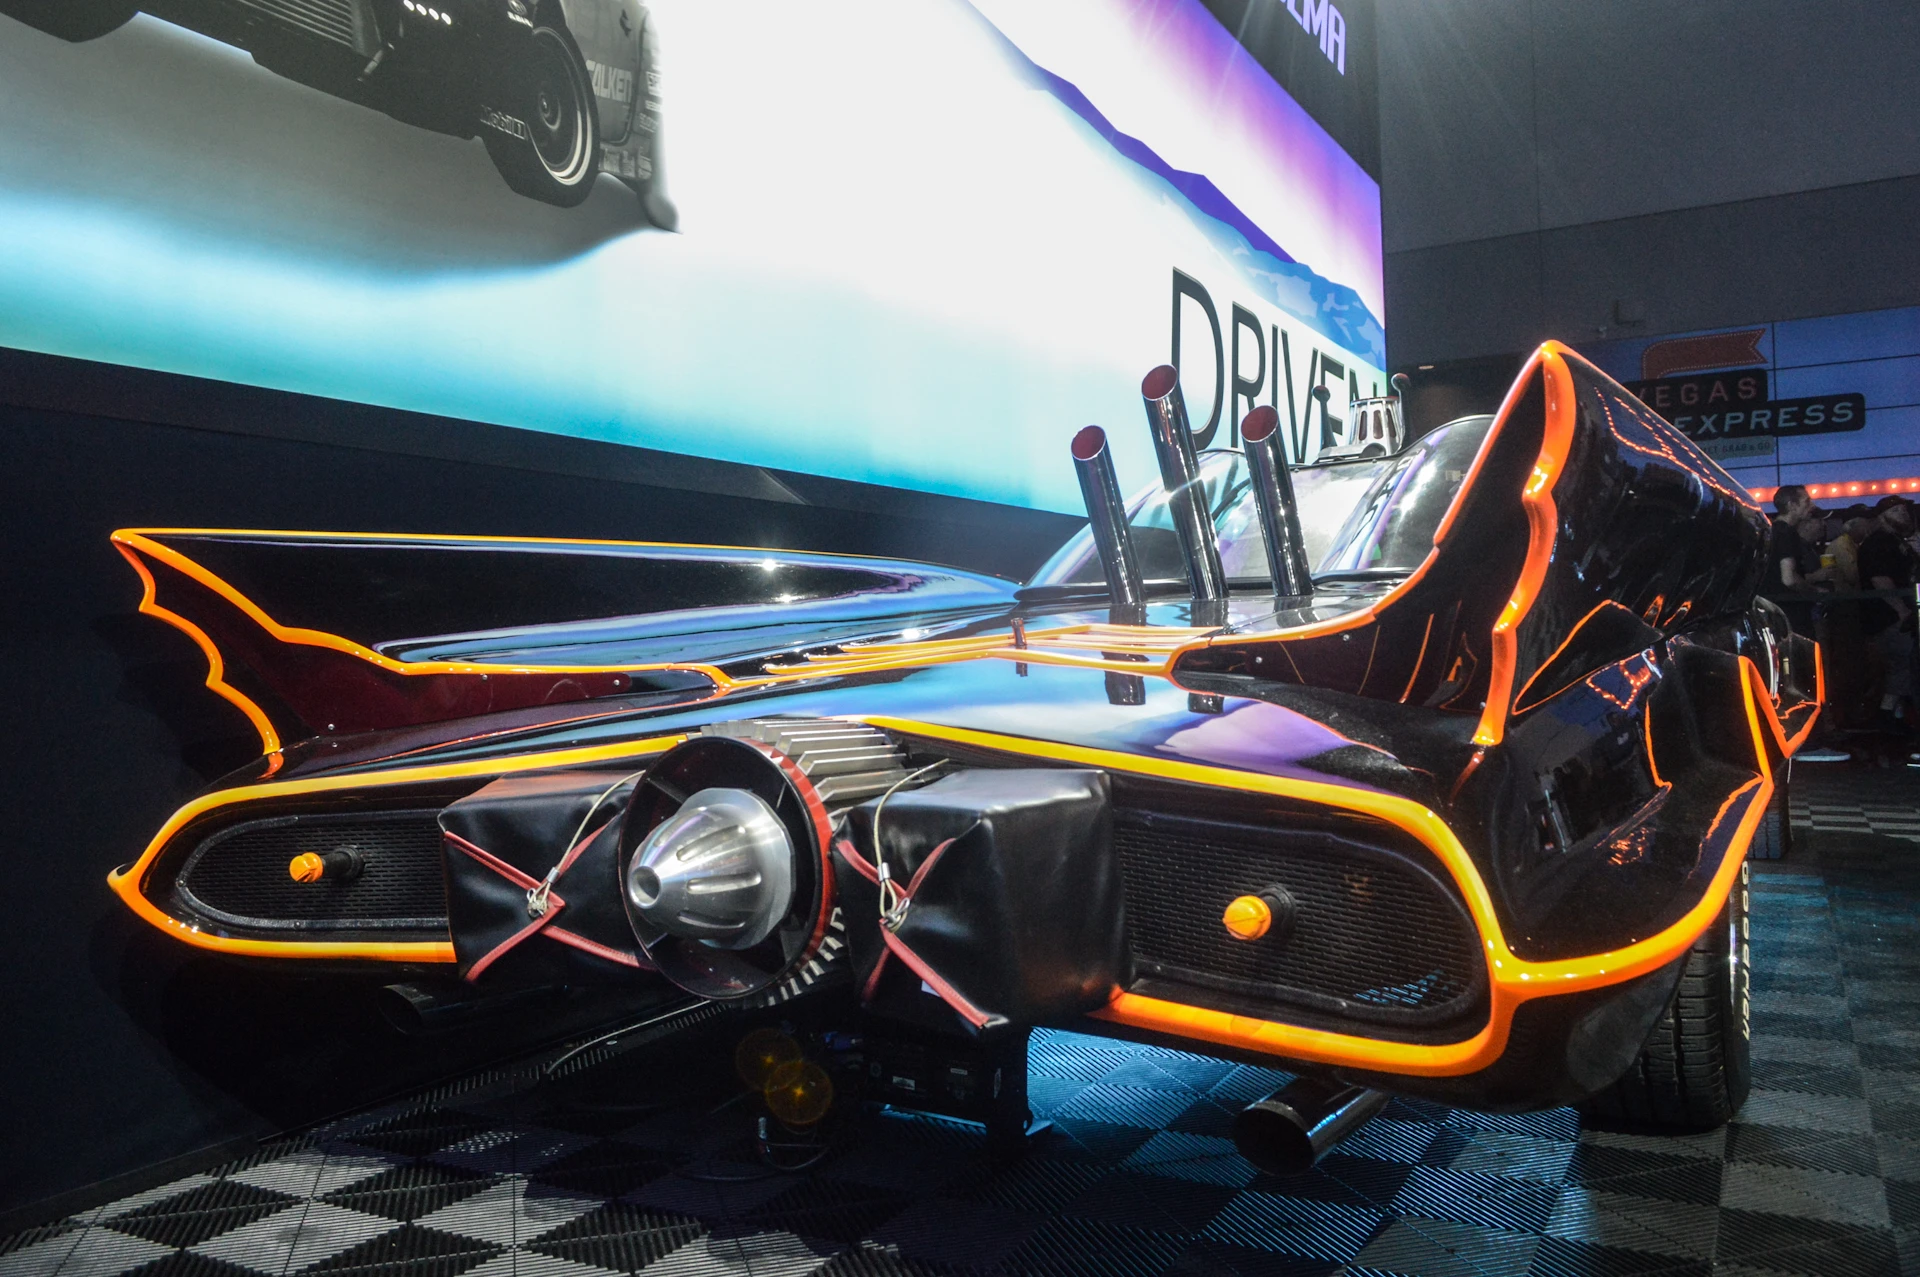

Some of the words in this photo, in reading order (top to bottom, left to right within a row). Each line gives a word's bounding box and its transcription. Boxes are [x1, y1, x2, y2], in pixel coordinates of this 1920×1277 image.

[1280, 0, 1346, 76] MA
[1171, 265, 1379, 464] DRIVE
[1673, 402, 1854, 436] EXPRESS
